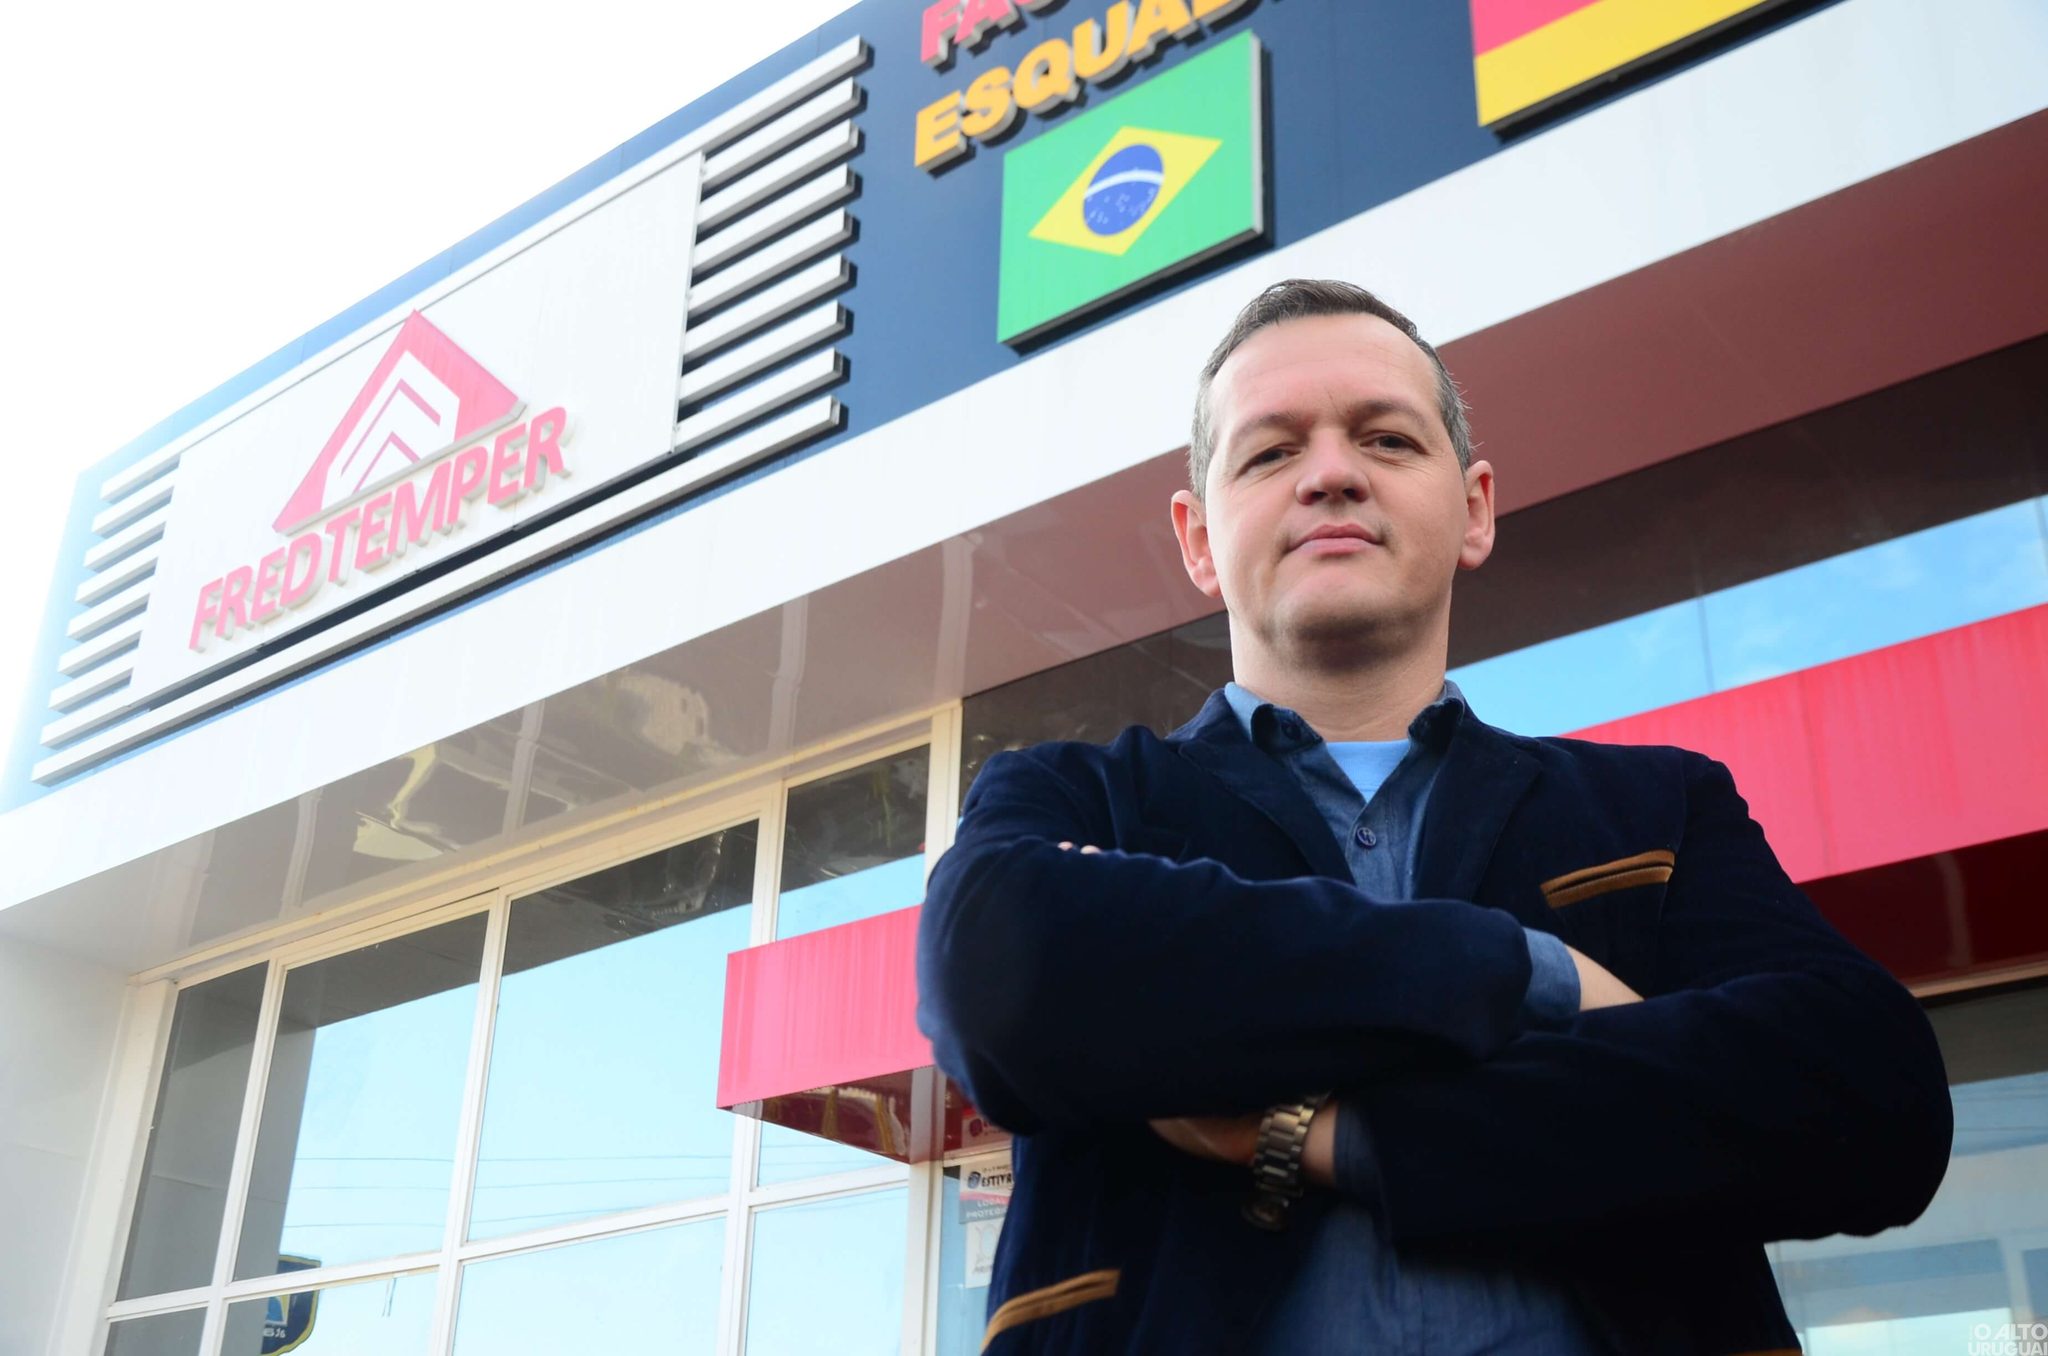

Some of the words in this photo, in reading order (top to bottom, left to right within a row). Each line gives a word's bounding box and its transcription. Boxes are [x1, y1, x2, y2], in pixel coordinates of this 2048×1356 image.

[914, 0, 1238, 169] ESQUA
[920, 0, 1036, 65] FA
[188, 406, 568, 652] FREDTEMPER
